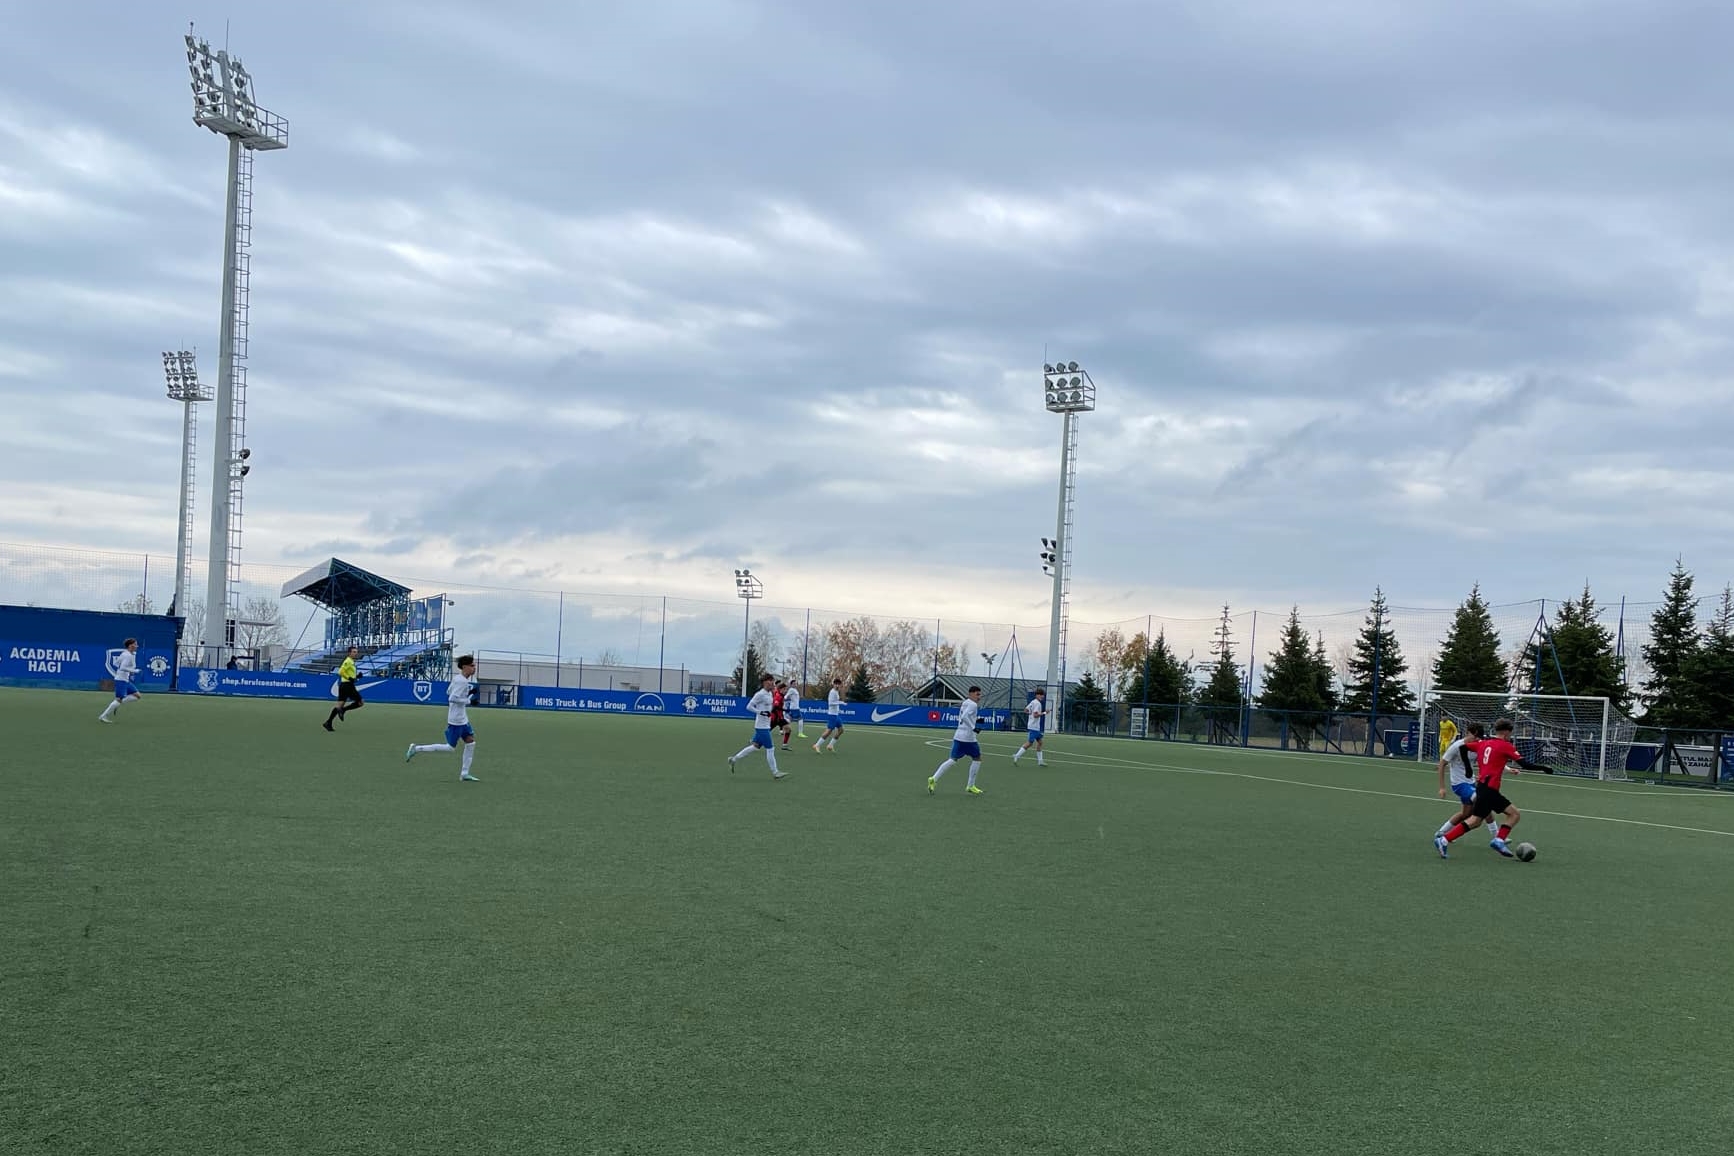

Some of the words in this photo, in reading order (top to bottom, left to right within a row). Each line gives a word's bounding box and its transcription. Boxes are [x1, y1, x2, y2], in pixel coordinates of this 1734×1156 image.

[10, 647, 80, 662] ACADEMIA
[28, 660, 62, 673] HAGI
[417, 685, 428, 693] BT
[535, 697, 553, 707] MHS
[555, 698, 577, 707] Truck
[579, 699, 586, 708] &
[587, 700, 602, 708] Bus
[603, 701, 627, 711] Group
[702, 698, 737, 707] ACADEMIA
[711, 705, 728, 713] HAGI
[996, 715, 1005, 723] TV
[1483, 746, 1492, 765] 9
